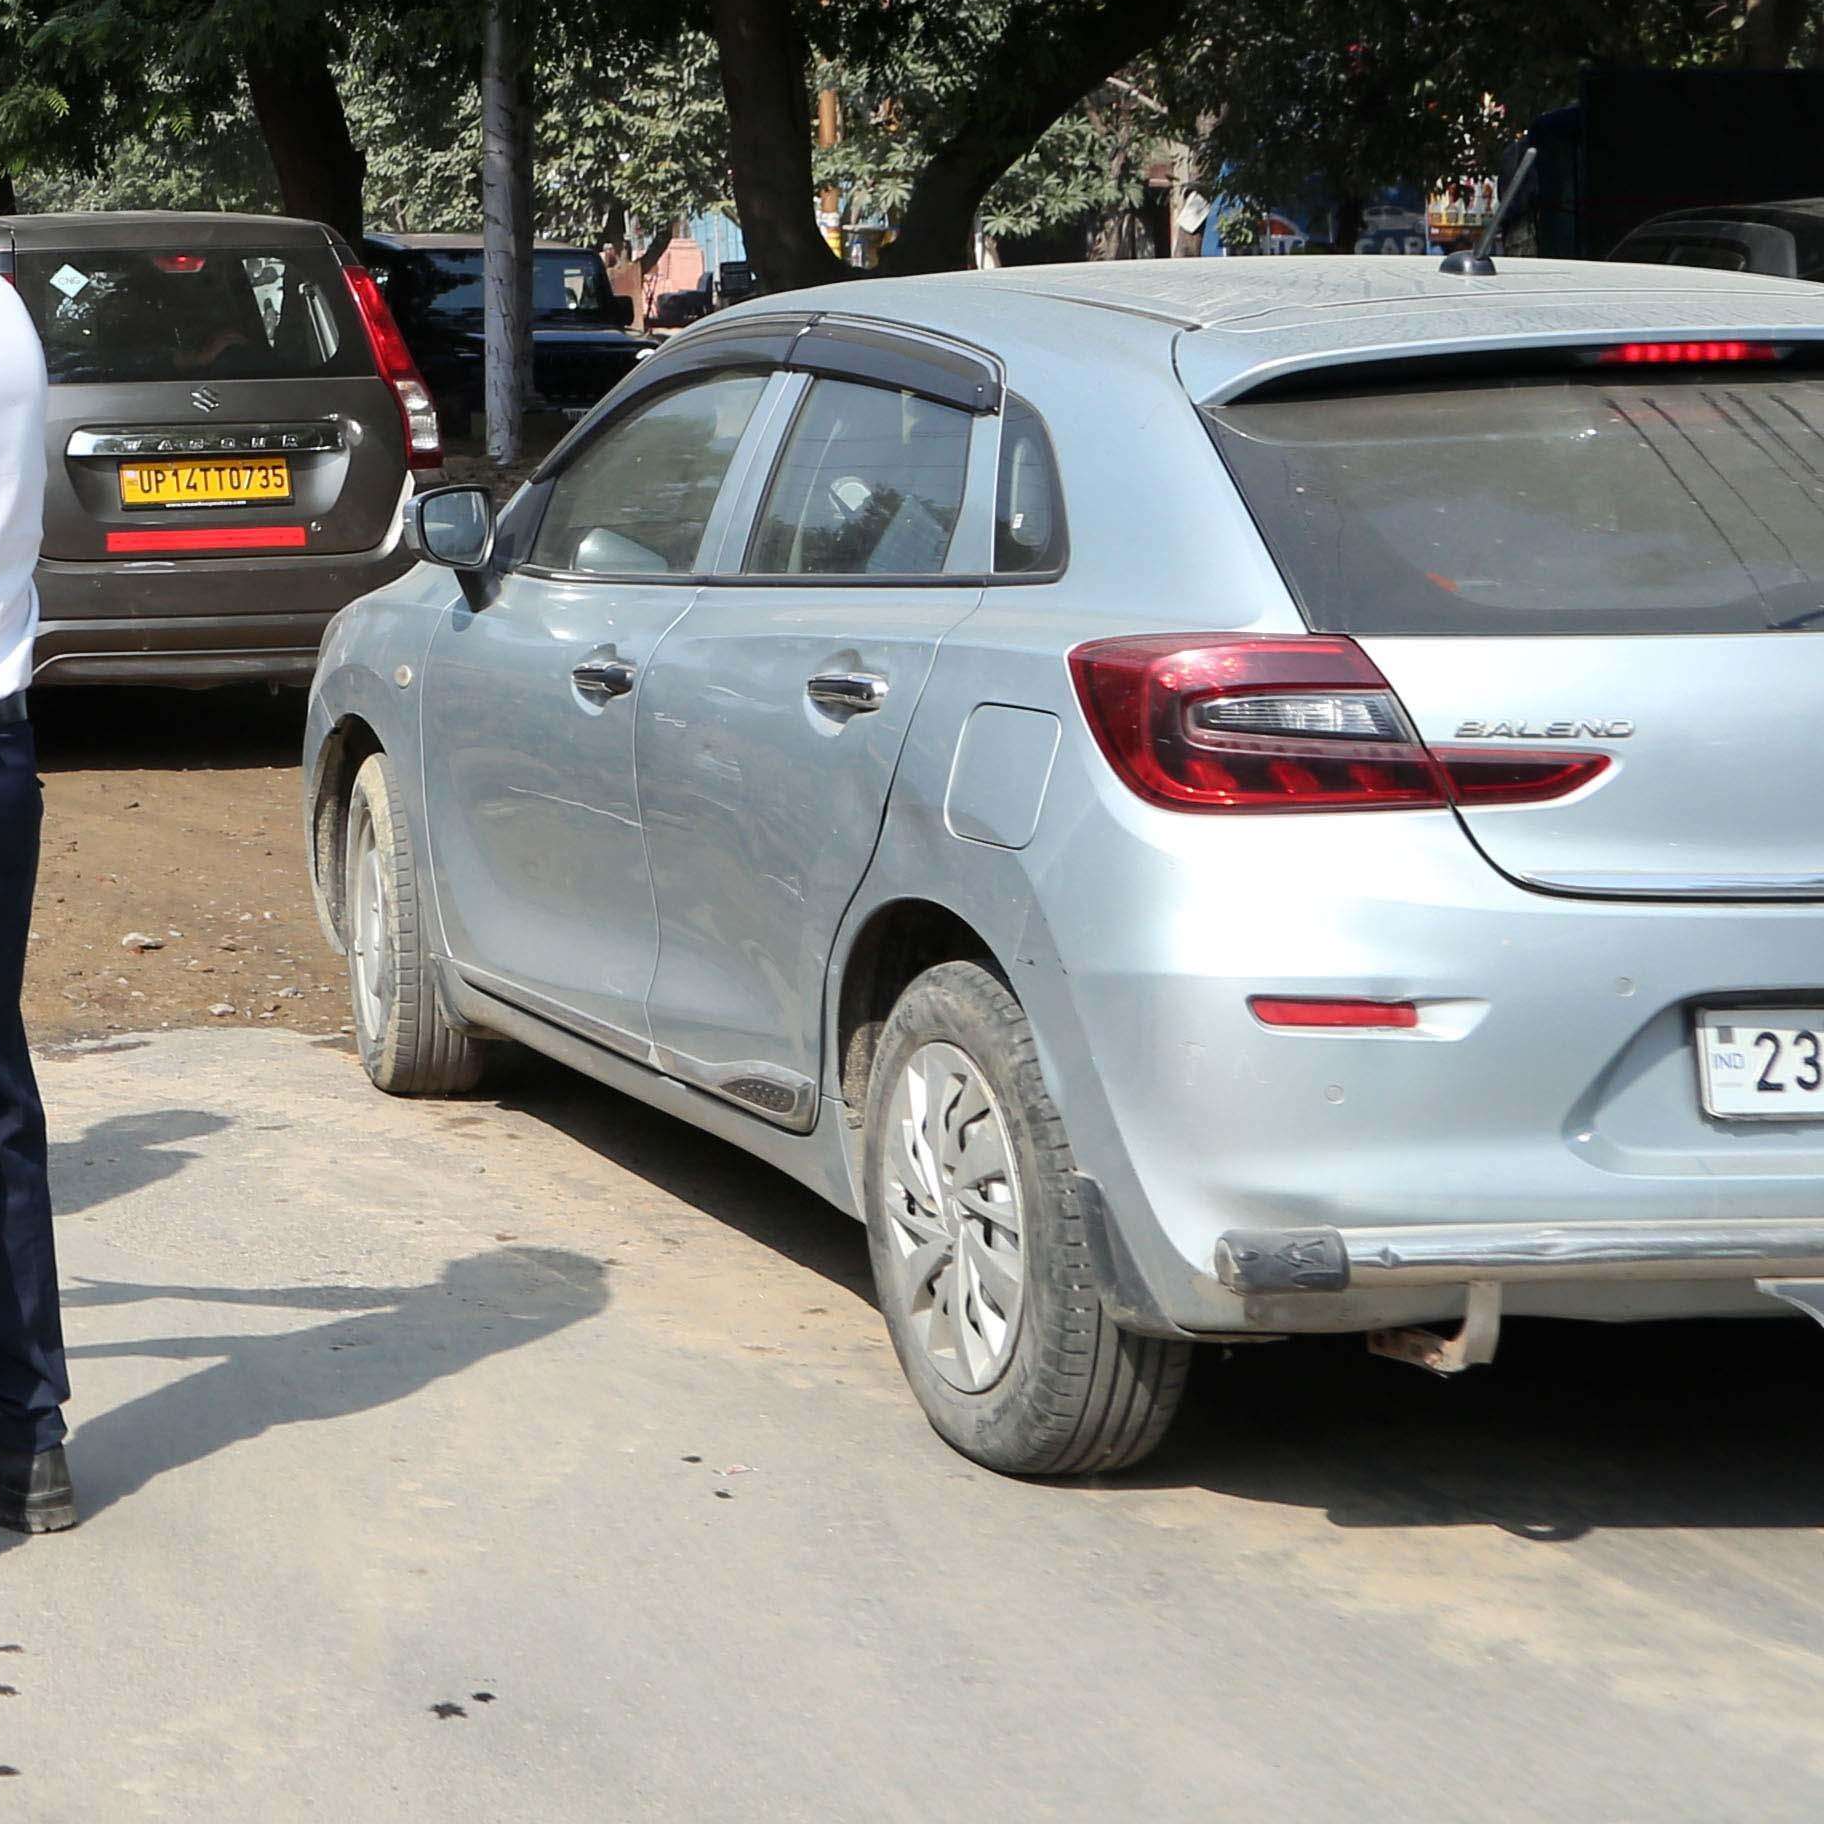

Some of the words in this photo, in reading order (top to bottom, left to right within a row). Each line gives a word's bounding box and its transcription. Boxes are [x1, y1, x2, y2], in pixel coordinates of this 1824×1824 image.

[58, 277, 81, 285] CNG
[138, 465, 286, 494] UP14TT0735
[1453, 719, 1636, 739] BALENO
[1754, 1031, 1821, 1092] 23
